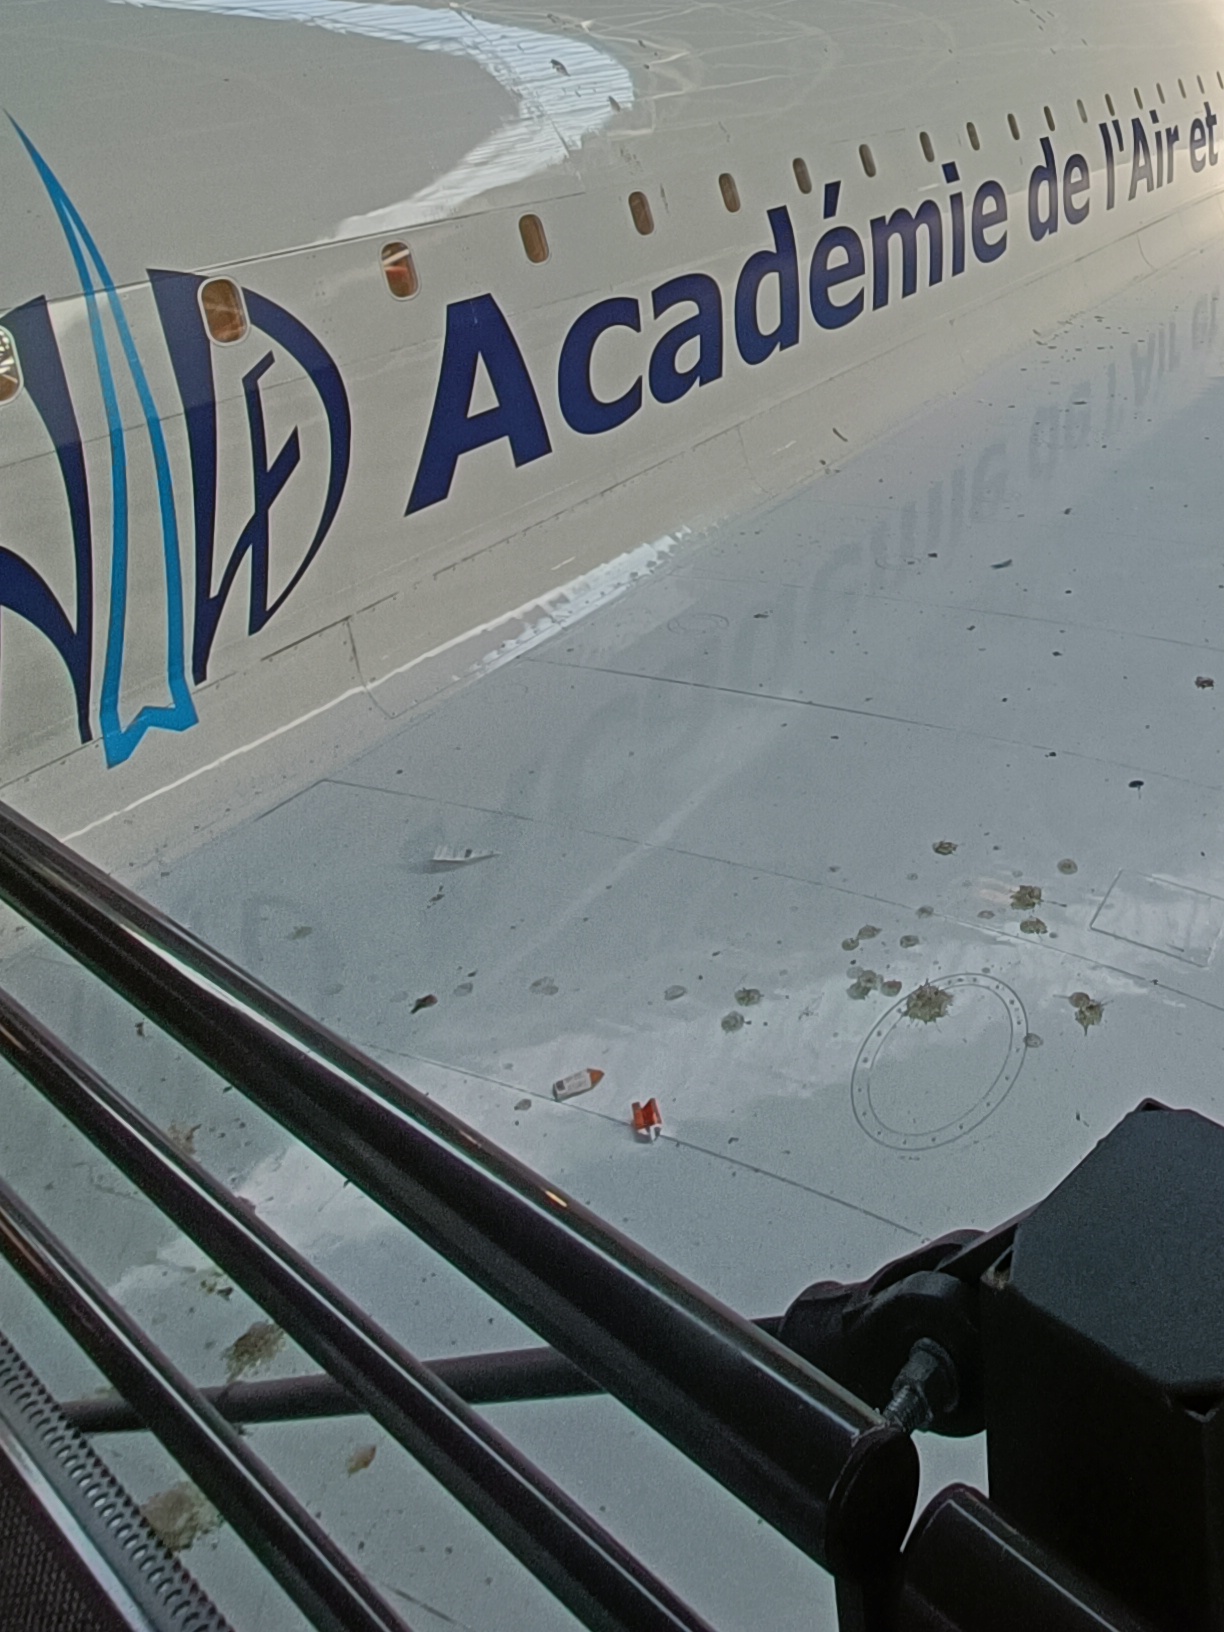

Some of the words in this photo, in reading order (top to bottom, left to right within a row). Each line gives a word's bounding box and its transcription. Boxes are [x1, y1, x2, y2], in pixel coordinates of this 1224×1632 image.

[404, 161, 1009, 518] Académie
[1028, 136, 1091, 242] de
[1098, 109, 1180, 211] l'Air
[1189, 101, 1219, 173] et
